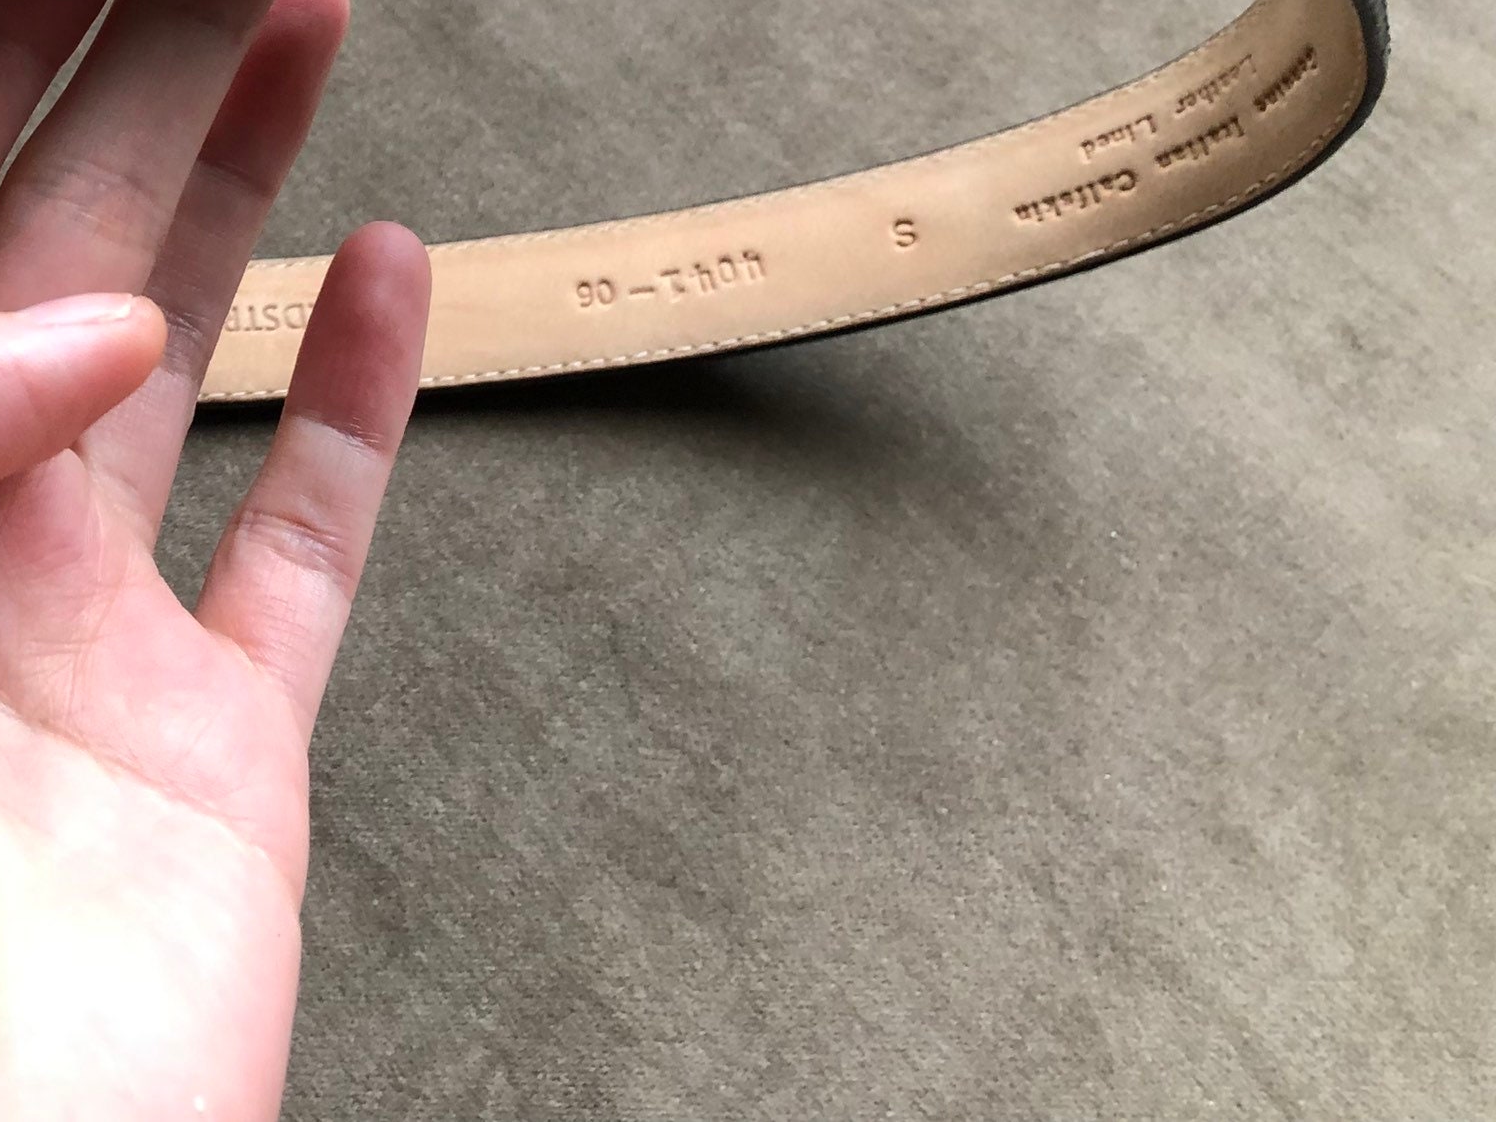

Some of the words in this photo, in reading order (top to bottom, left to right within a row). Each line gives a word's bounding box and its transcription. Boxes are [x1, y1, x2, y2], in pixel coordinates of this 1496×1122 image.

[1176, 53, 1257, 113] Leather
[1080, 113, 1157, 160] Lined
[1155, 115, 1245, 168] Italian
[1014, 168, 1137, 222] Calfskin
[894, 217, 918, 249] S
